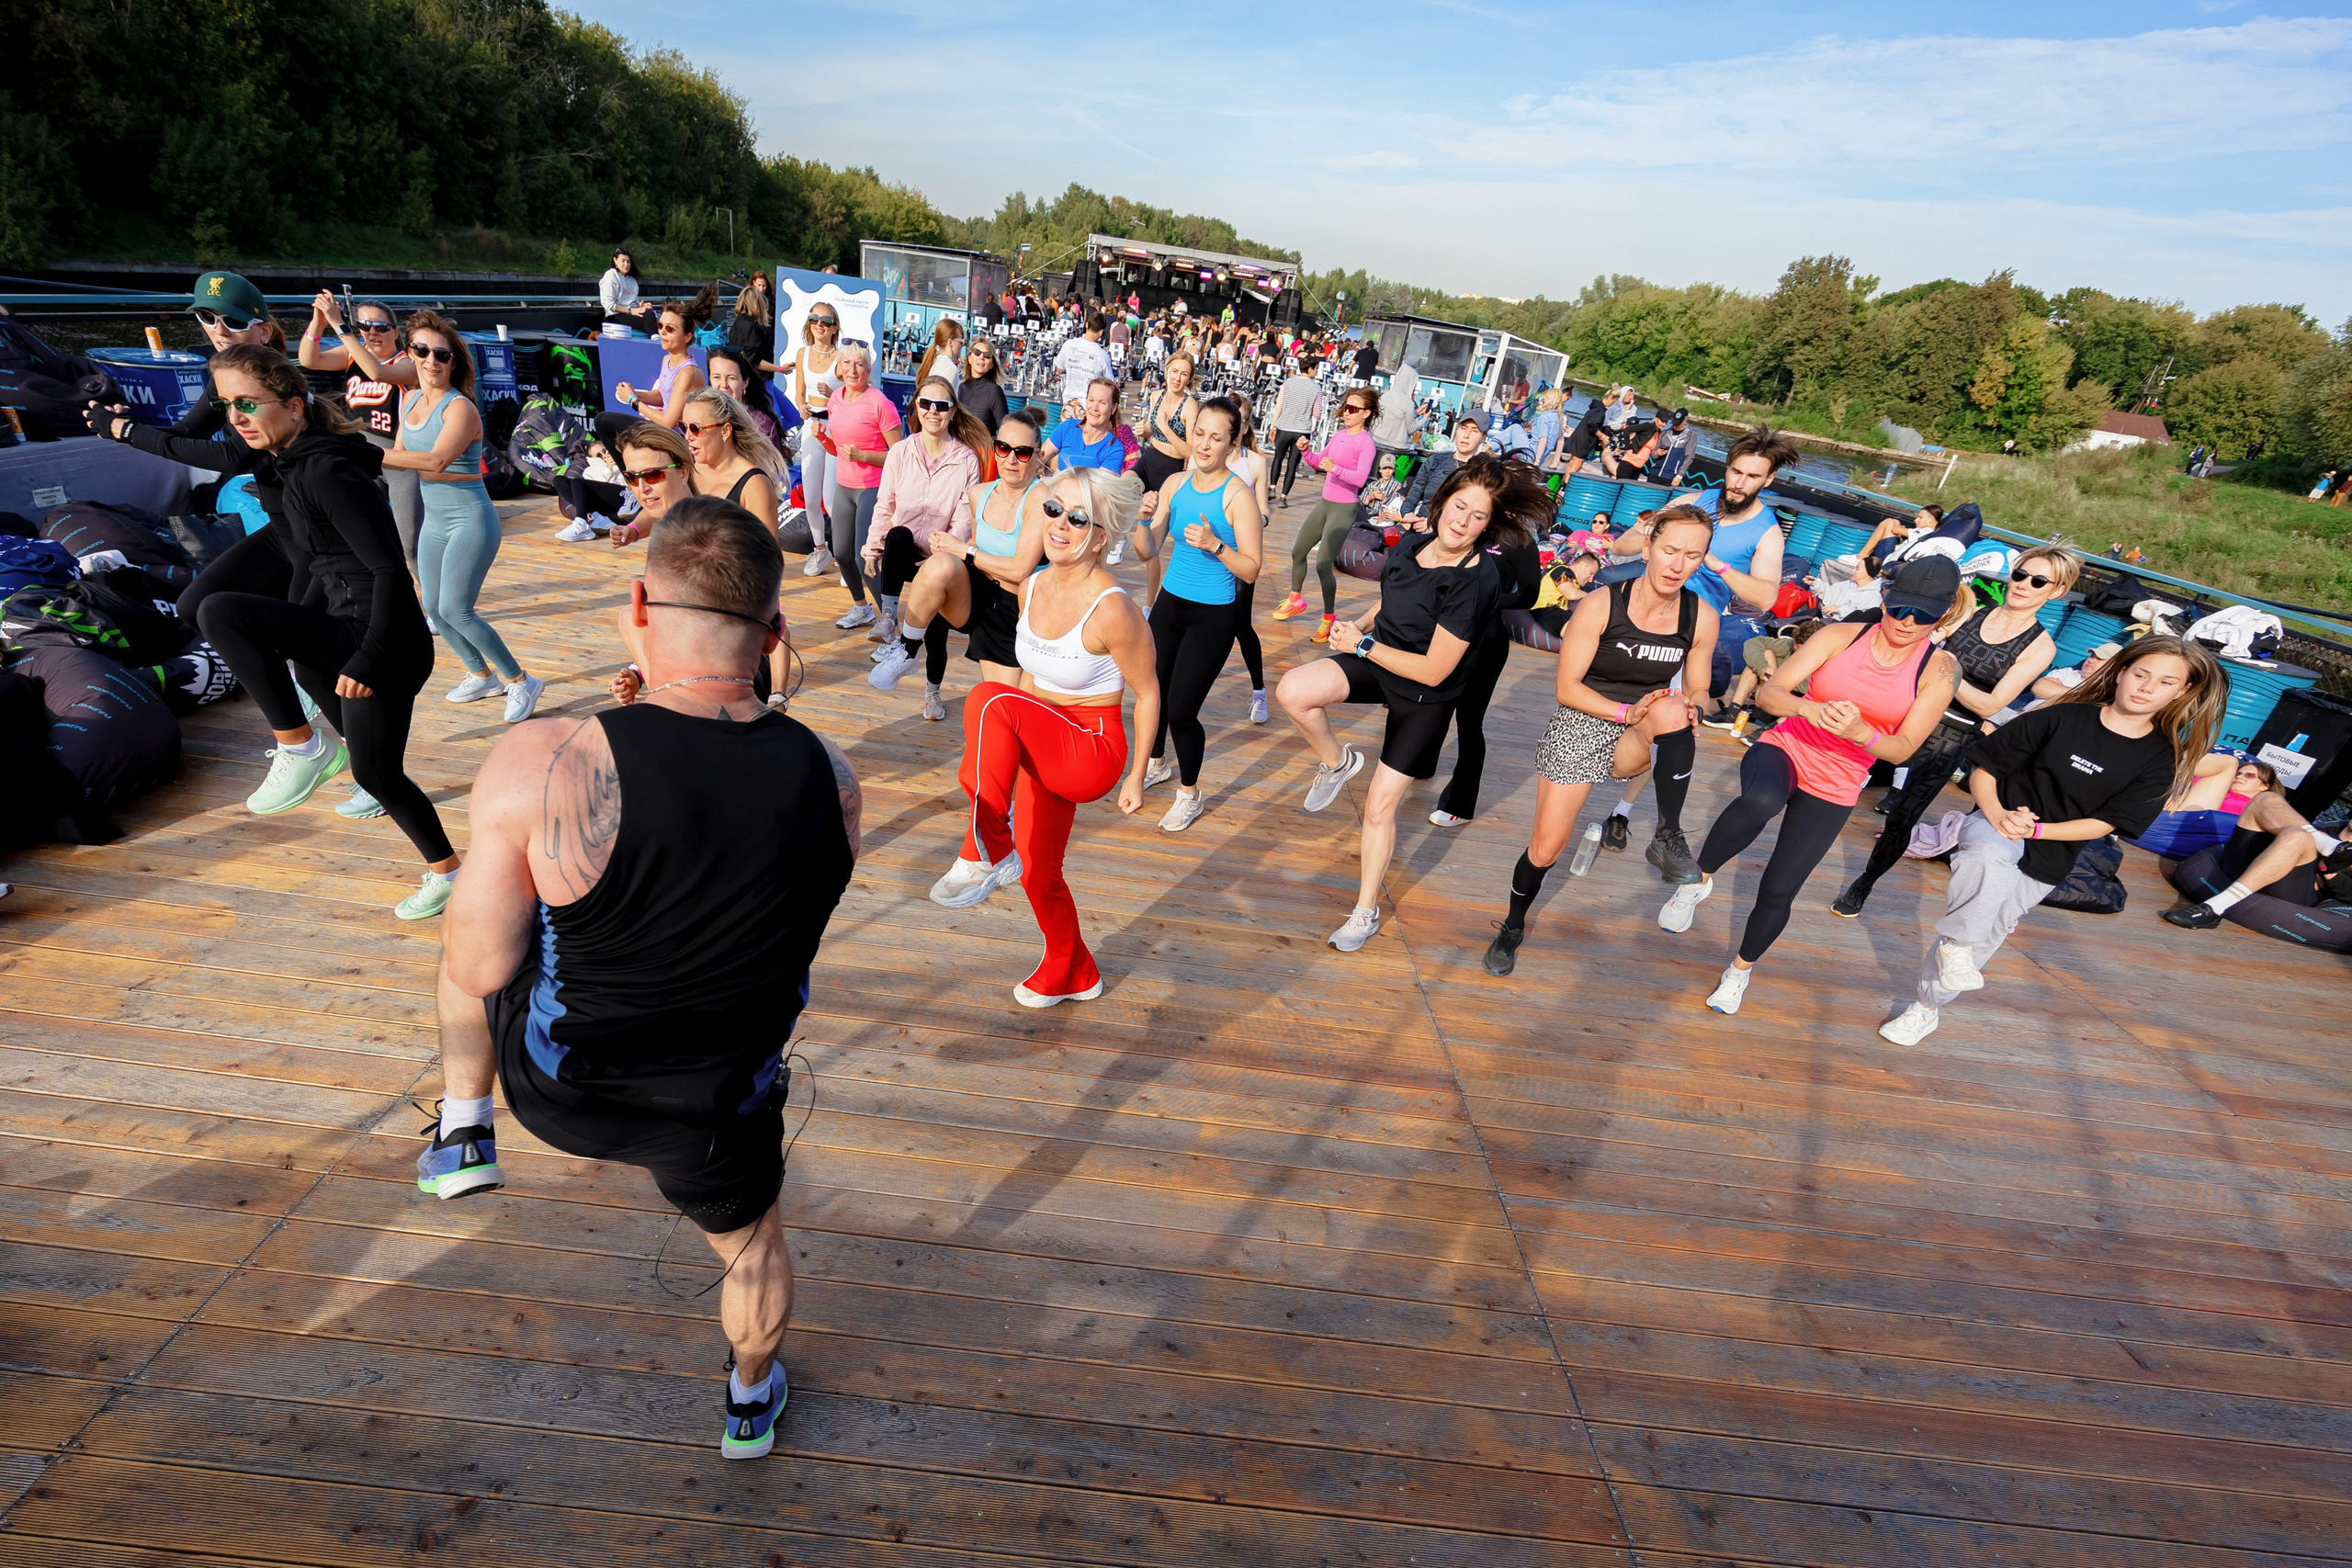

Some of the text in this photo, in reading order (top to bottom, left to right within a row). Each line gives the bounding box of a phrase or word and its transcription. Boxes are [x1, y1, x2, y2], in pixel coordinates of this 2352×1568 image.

[177, 374, 203, 384] ХАСКИ
[345, 375, 392, 409] Puma
[370, 410, 391, 433] 22
[1636, 644, 1684, 662] PUMA
[2070, 754, 2094, 768] DELETE
[2071, 761, 2094, 775] DRAMA
[2266, 750, 2301, 769] БЫТОВЫЕ
